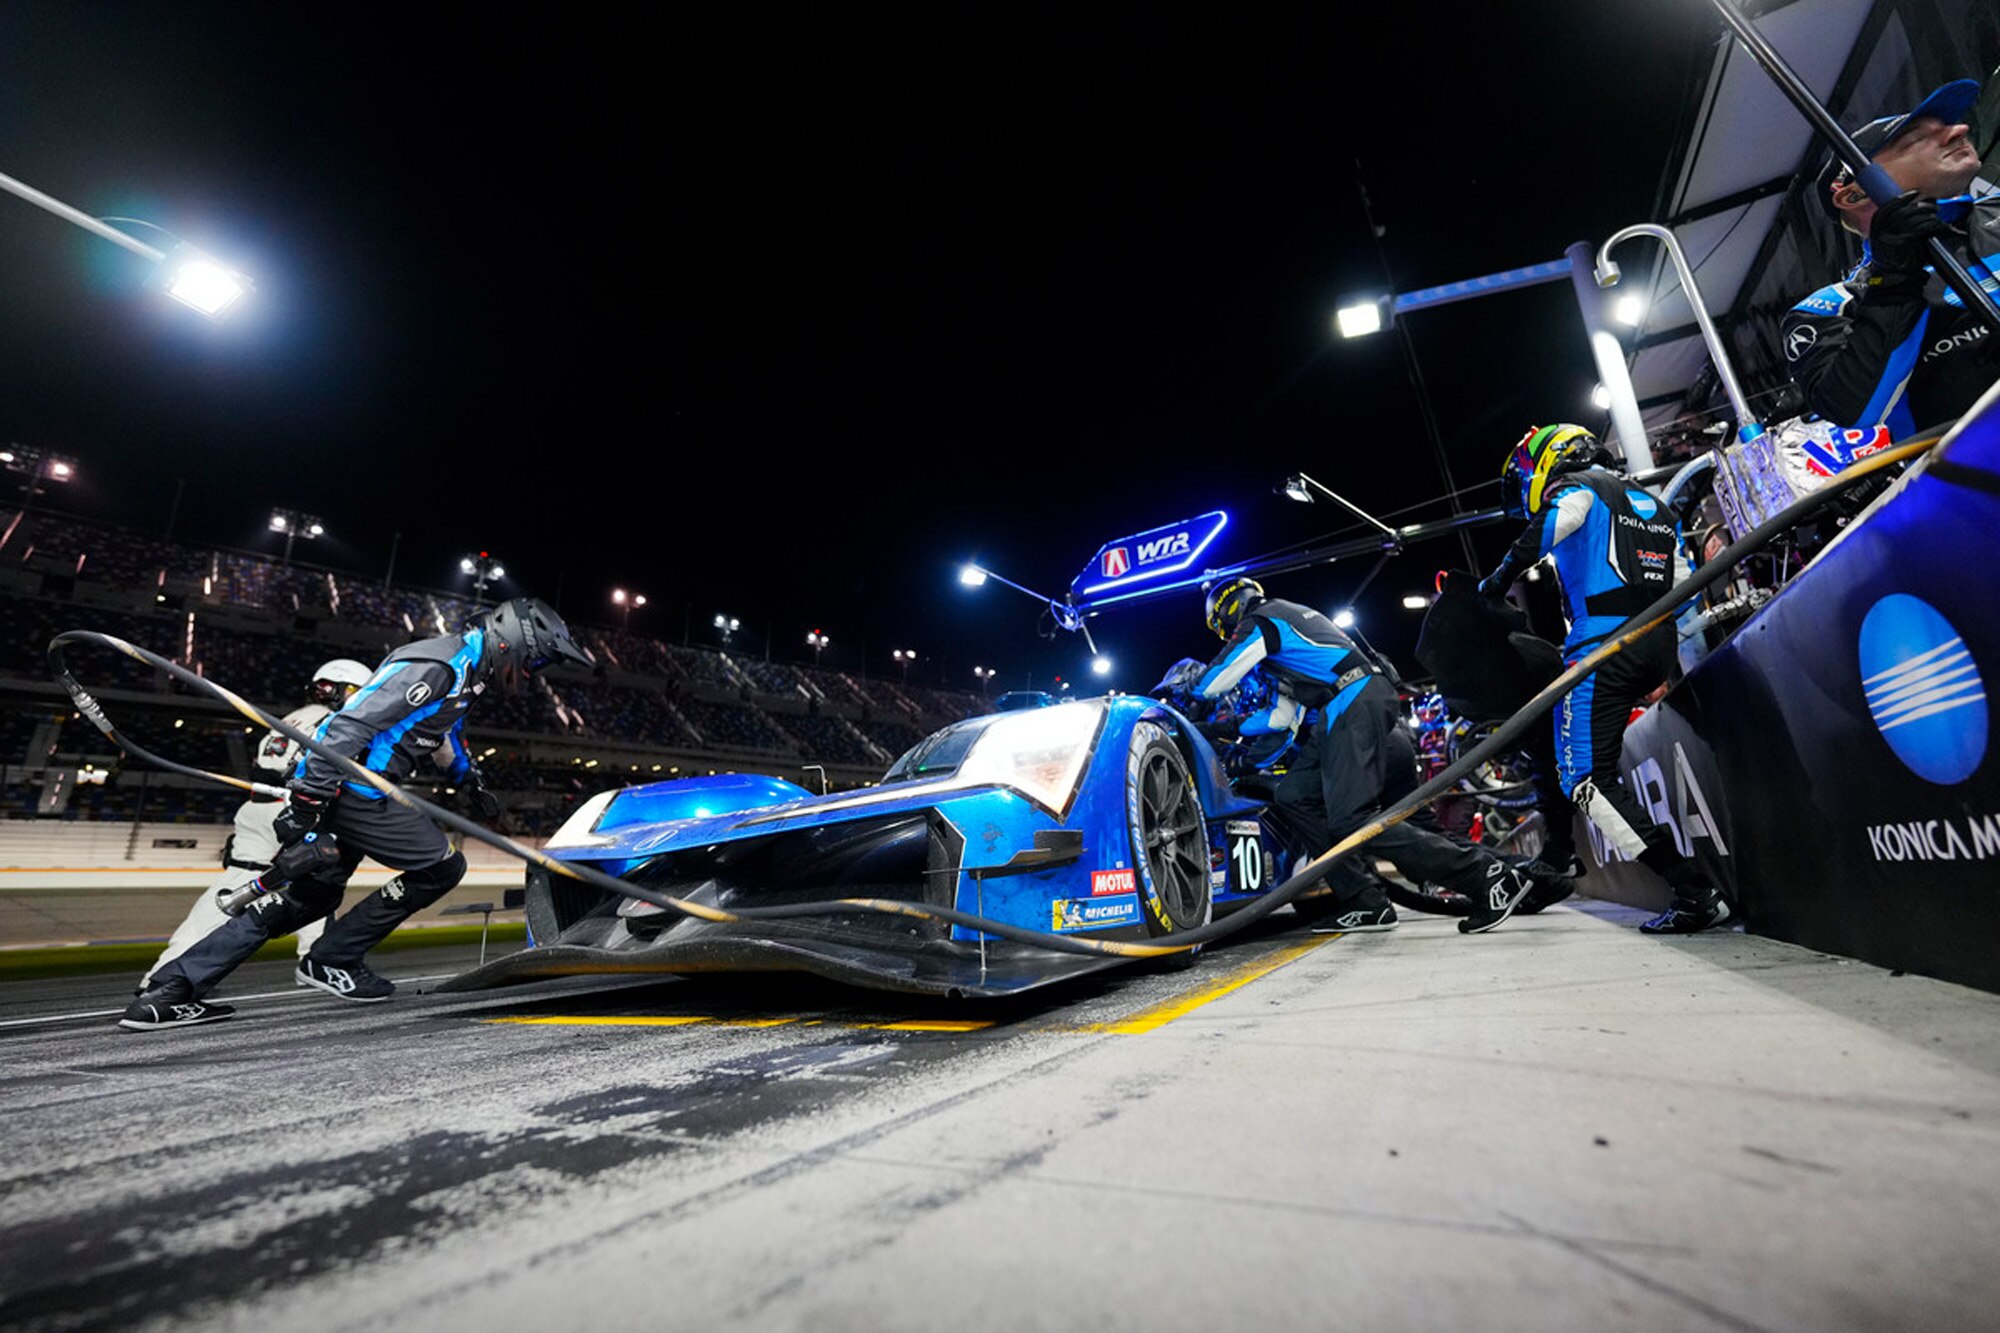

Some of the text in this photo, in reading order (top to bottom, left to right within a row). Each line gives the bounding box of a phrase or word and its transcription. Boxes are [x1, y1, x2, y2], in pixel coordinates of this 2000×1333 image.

[1137, 532, 1189, 561] WTR
[1866, 819, 1972, 861] KONICA
[1232, 836, 1261, 890] 10
[1094, 872, 1134, 892] MOTUL
[1084, 903, 1134, 919] MICHELIN
